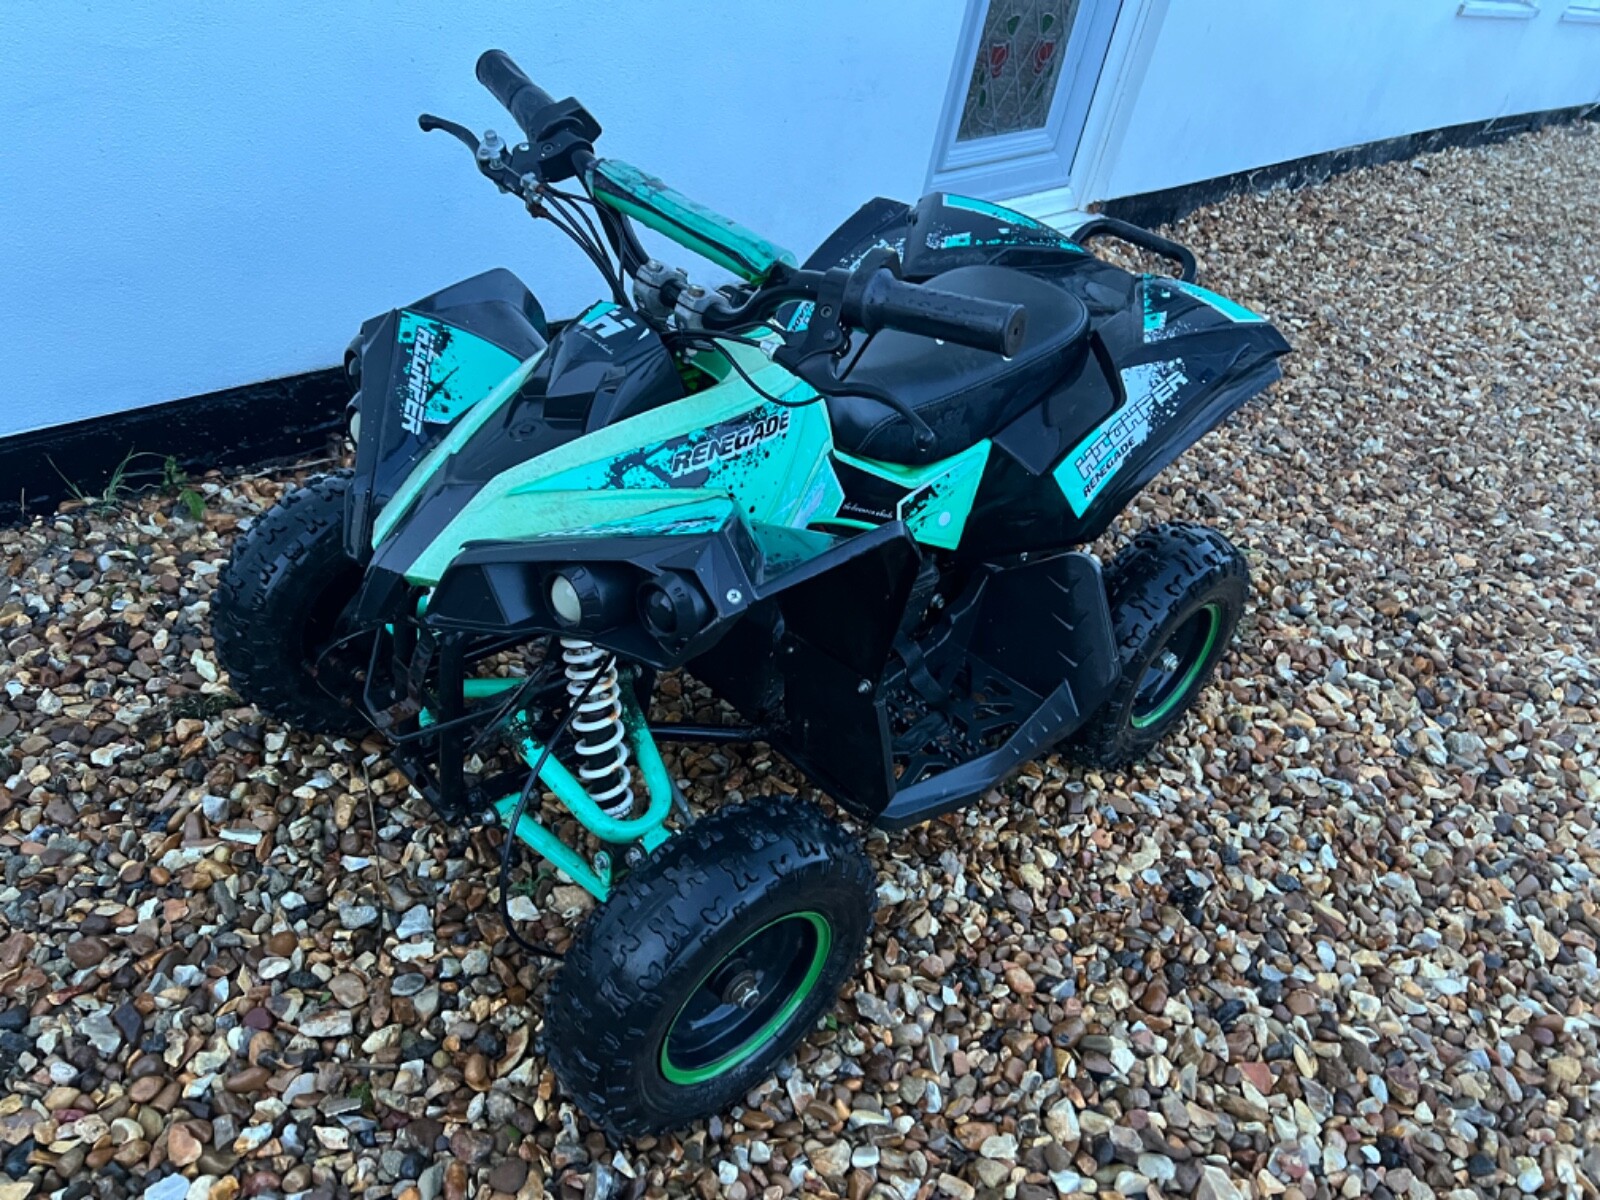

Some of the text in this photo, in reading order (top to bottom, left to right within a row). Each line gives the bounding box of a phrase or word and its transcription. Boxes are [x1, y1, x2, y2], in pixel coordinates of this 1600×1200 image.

[671, 409, 791, 479] RENEGADE
[1074, 370, 1189, 481] HIGHPER
[1083, 435, 1136, 498] RENEGADE
